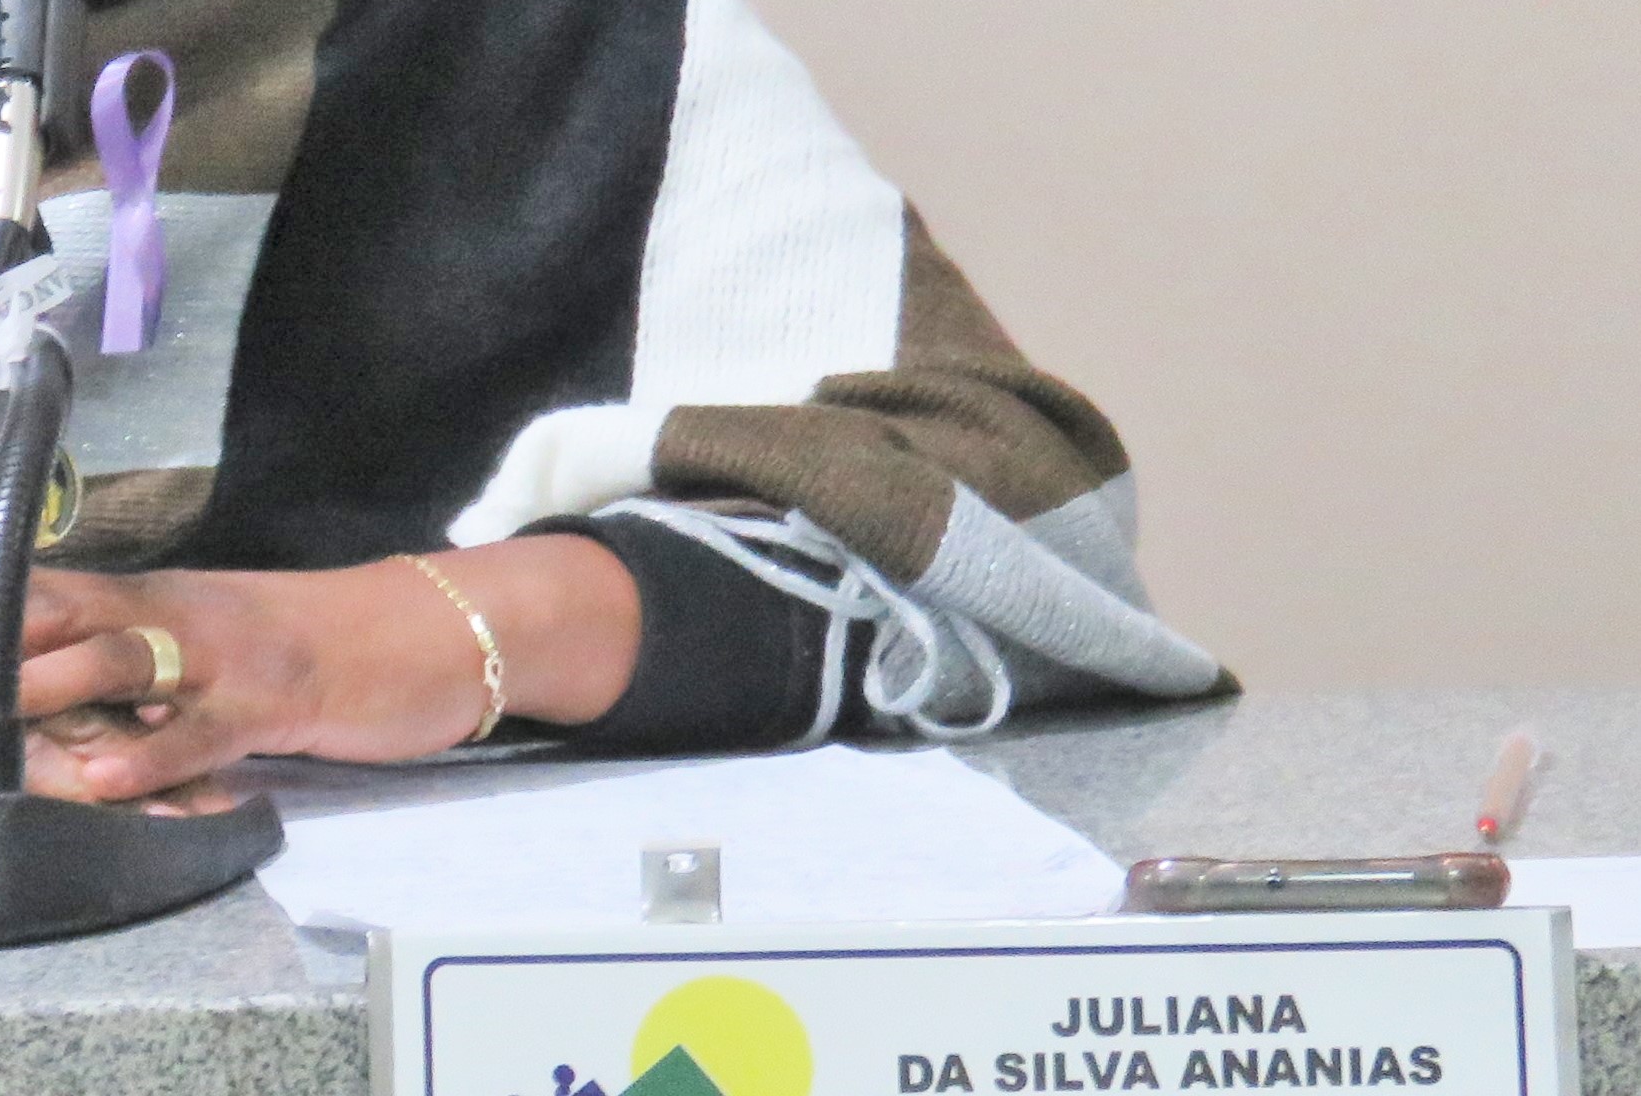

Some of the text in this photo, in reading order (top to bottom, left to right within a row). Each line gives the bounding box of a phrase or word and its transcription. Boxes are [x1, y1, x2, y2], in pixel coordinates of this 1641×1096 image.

[1051, 994, 1307, 1038] JULIANA
[897, 1045, 1443, 1094] DA SILVA ANANIAS
